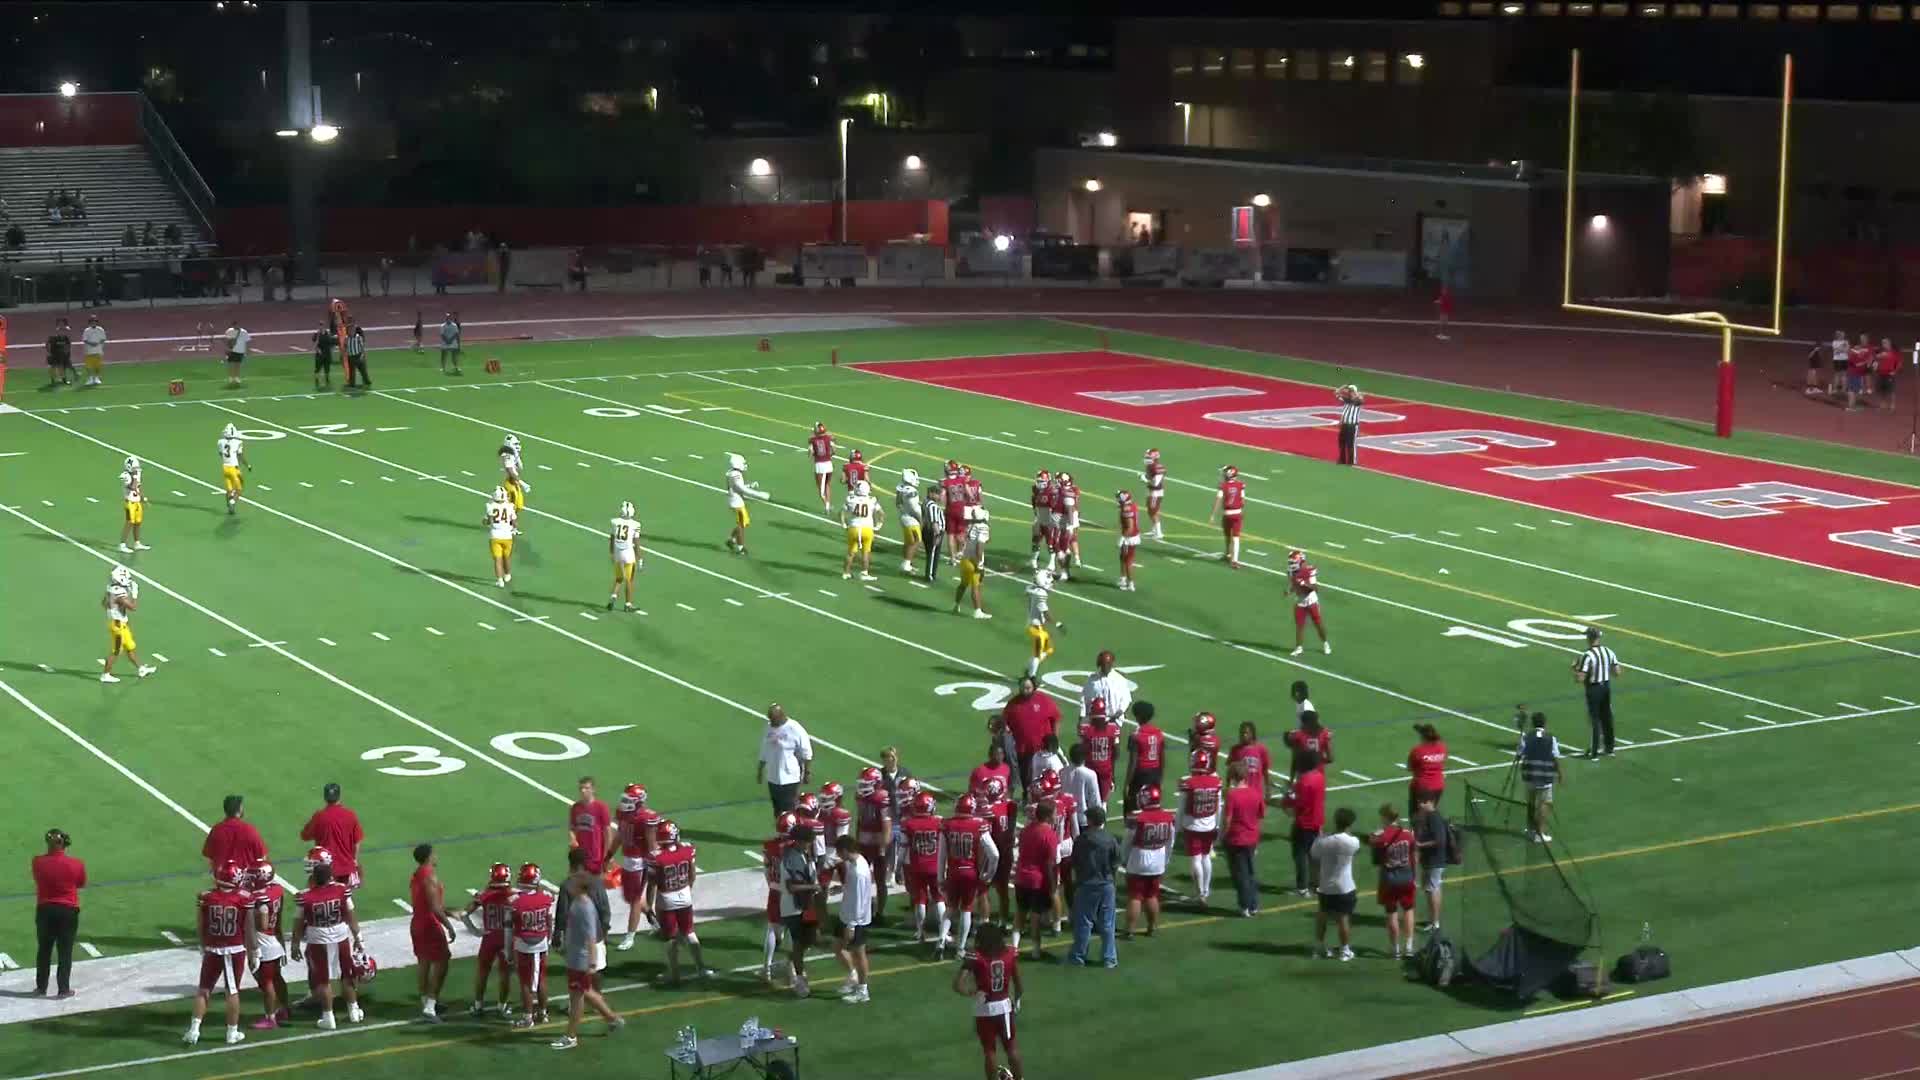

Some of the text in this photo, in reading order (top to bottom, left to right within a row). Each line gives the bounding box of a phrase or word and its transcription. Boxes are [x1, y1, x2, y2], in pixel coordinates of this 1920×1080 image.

[237, 424, 366, 440] 20
[223, 445, 232, 459] 3
[492, 508, 508, 524] 24
[853, 504, 869, 518] 40
[615, 525, 629, 541] 13
[1440, 619, 1602, 648] 10
[360, 731, 591, 776] 30
[208, 904, 238, 937] 58
[991, 960, 1005, 992] 8
